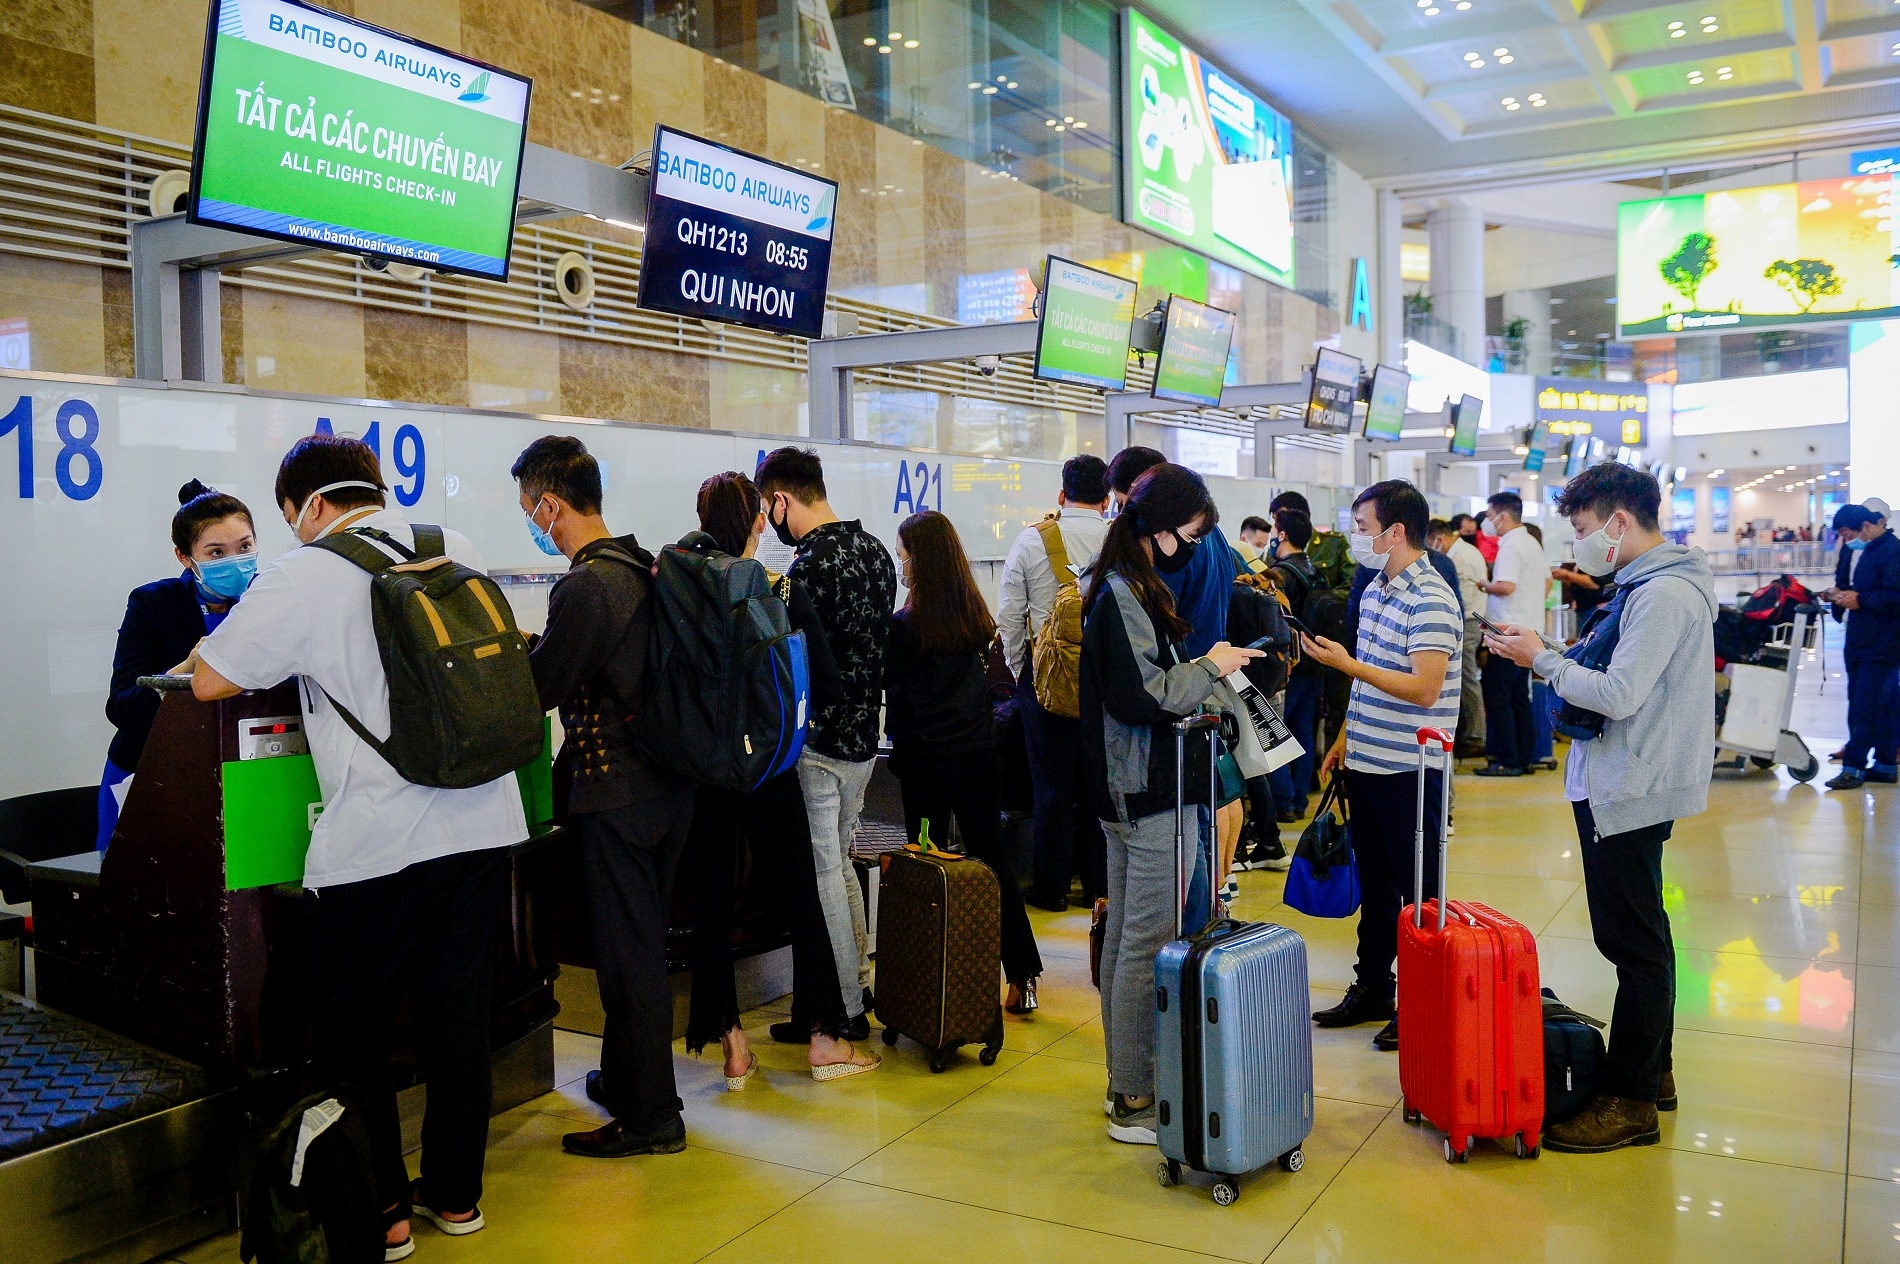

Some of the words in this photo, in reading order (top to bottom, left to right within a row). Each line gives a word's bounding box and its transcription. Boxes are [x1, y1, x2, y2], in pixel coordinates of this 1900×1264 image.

[269, 13, 368, 58] BAMBOO
[374, 49, 462, 89] AIRWAYS
[235, 80, 282, 132] TẤT
[285, 96, 317, 142] CẢ
[322, 110, 369, 154] CÁC
[373, 127, 460, 178] CHUYẾN
[462, 154, 503, 188] BAY
[280, 151, 312, 174] ALL
[316, 159, 383, 190] FLIGHTS
[386, 176, 457, 207] CHECK-IN
[658, 151, 736, 193] BAMBOO
[741, 177, 811, 215] AIRWAYS
[288, 223, 440, 262] www.bambooairways.com
[677, 217, 748, 256] QH1213
[766, 240, 808, 270] 08:55
[681, 269, 724, 305] QUI
[730, 278, 795, 319] NHON
[1062, 270, 1089, 286] BAMBOO
[1351, 257, 1373, 332] A
[893, 460, 941, 514] A21
